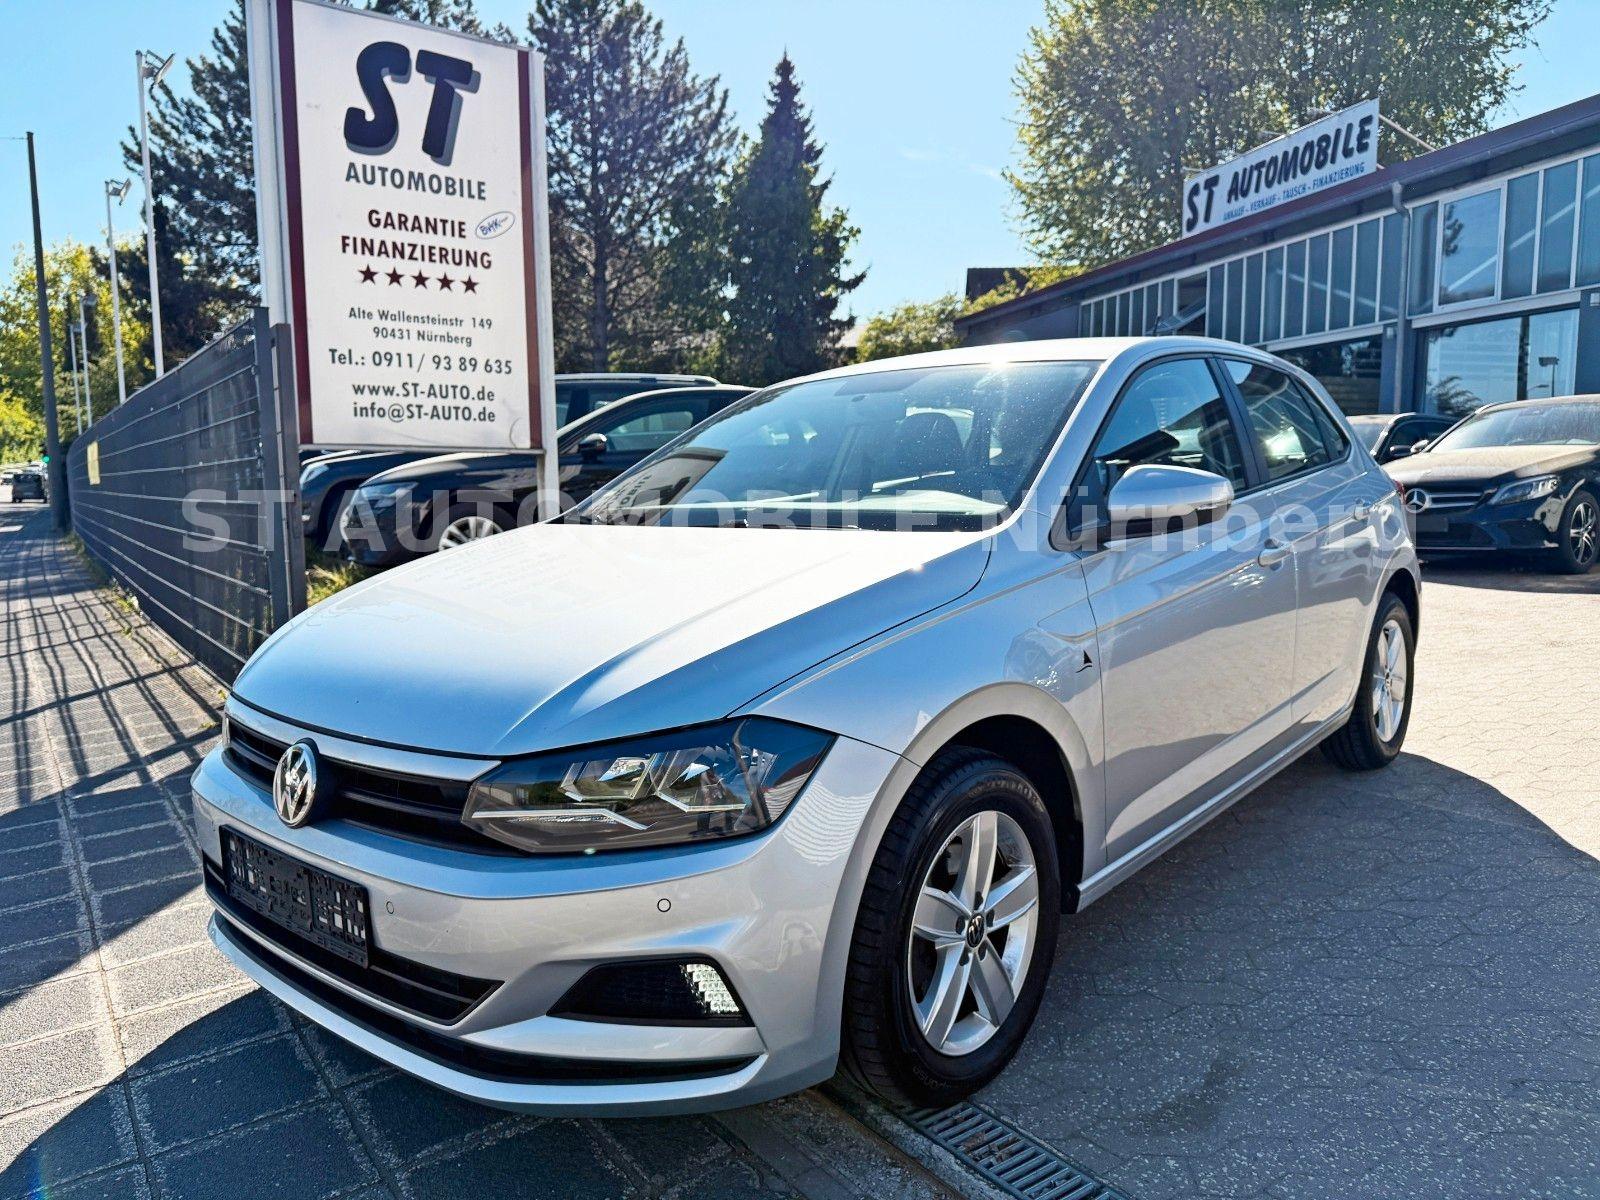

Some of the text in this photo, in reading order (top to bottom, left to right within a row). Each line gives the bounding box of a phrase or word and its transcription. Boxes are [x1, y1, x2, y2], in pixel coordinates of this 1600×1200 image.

[343, 41, 482, 167] ST
[345, 161, 487, 201] AUTOMOBILE
[1186, 114, 1374, 232] ST AUTOMOBILE
[1282, 183, 1307, 201] TAUSCH
[1312, 162, 1366, 190] FINANZIERUNG
[367, 209, 467, 238] GARANTIE
[341, 235, 492, 269] FINANZIERUNG
[348, 307, 493, 329] Alte Wallensteinstr 149
[373, 327, 473, 347] 90431 Nürnberg
[329, 349, 366, 366] Tel.:
[432, 355, 452, 371] 93
[459, 358, 478, 372] 89
[484, 360, 512, 375] 635
[352, 382, 495, 401] www.ST-AUTO.de
[353, 402, 496, 422] info@ST-AUTO.de
